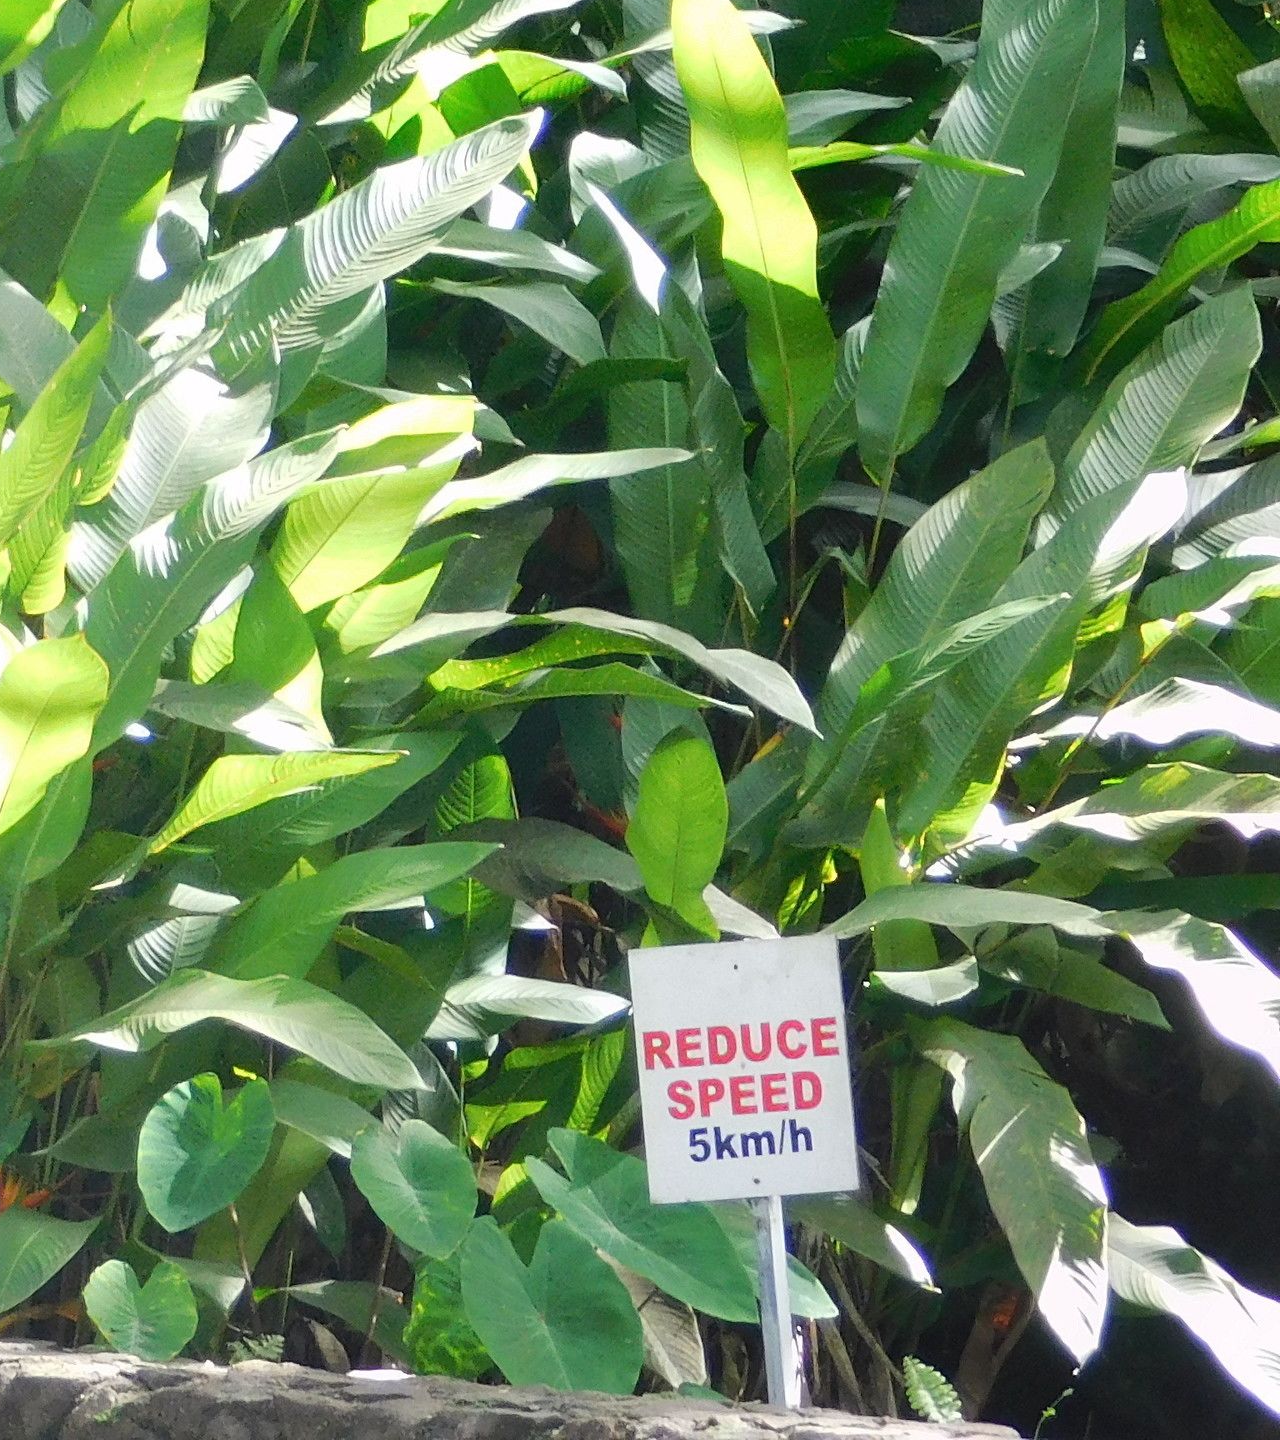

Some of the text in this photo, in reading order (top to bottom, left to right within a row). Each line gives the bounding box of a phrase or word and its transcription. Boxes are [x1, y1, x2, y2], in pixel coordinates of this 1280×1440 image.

[641, 1016, 840, 1071] REDUCE
[666, 1070, 823, 1120] SPEED
[688, 1118, 814, 1162] 5km/h
